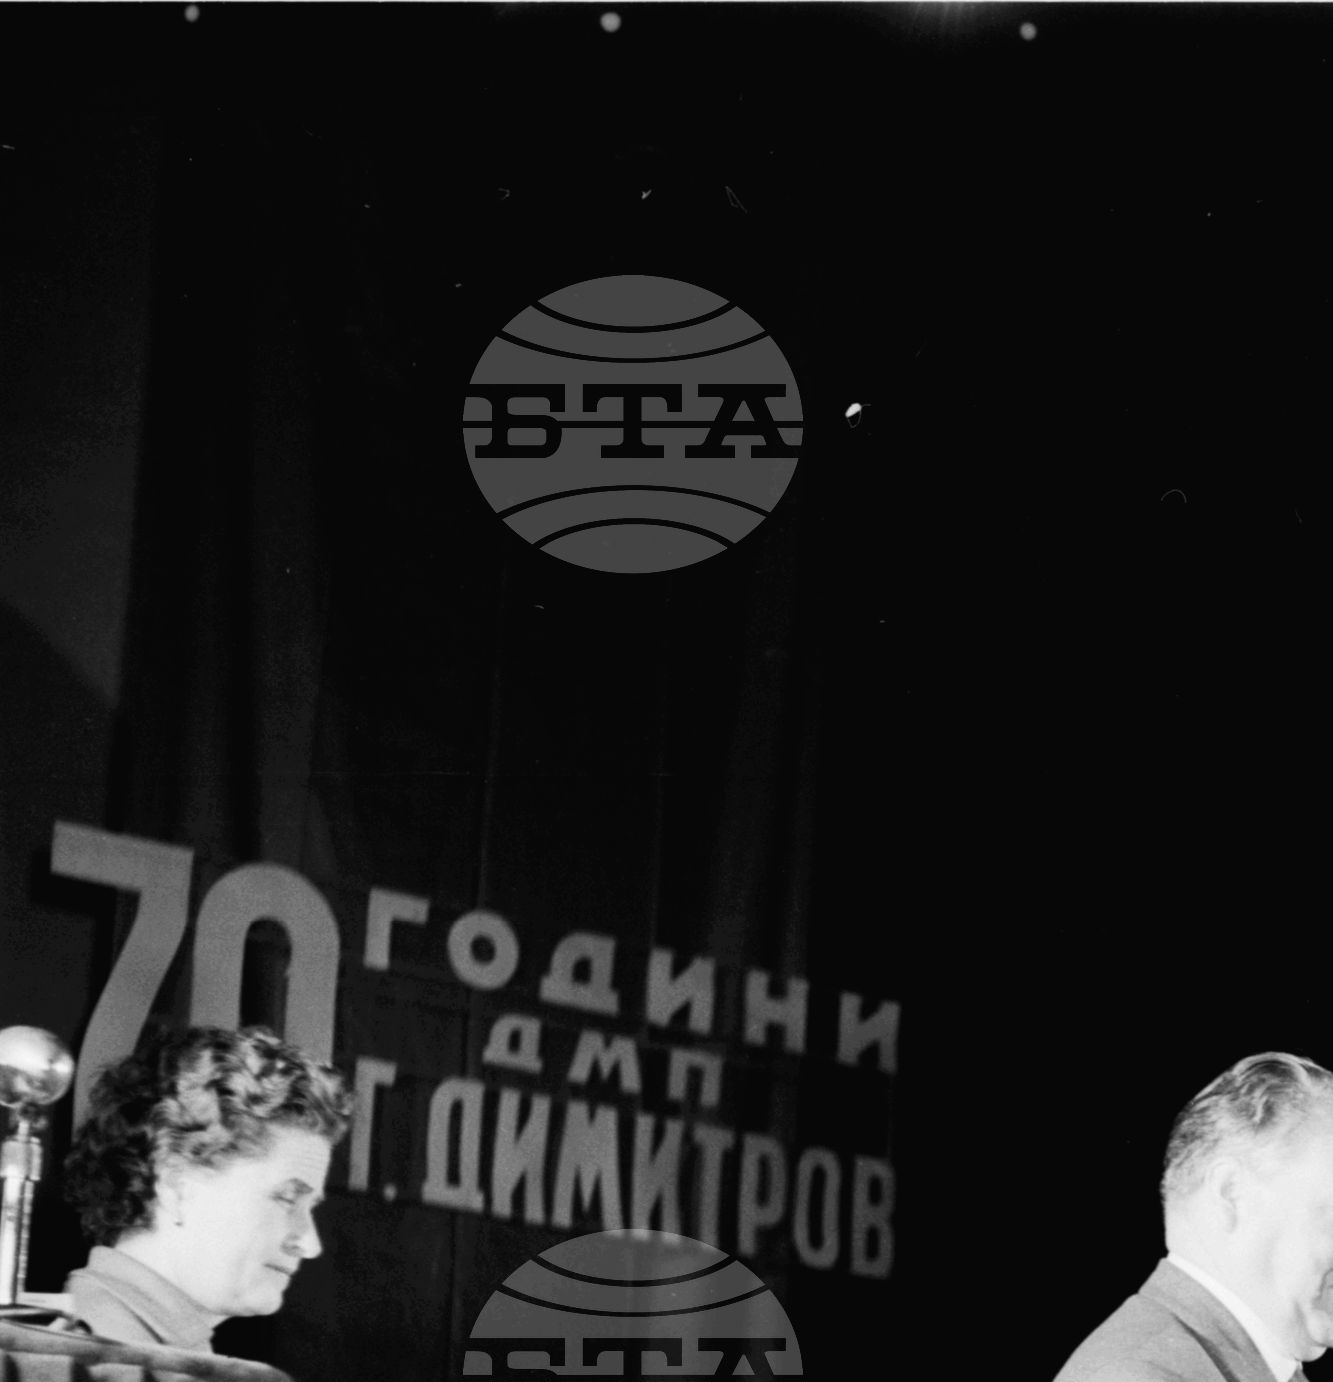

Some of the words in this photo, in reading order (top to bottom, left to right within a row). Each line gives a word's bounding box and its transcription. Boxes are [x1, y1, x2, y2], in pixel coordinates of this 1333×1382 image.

[51, 821, 341, 1146] 70
[365, 888, 900, 1074] ГОДИНИ
[484, 1014, 723, 1107] ДМП
[349, 1056, 397, 1200] Г.
[422, 1077, 897, 1279] ДИМИТРОВ
